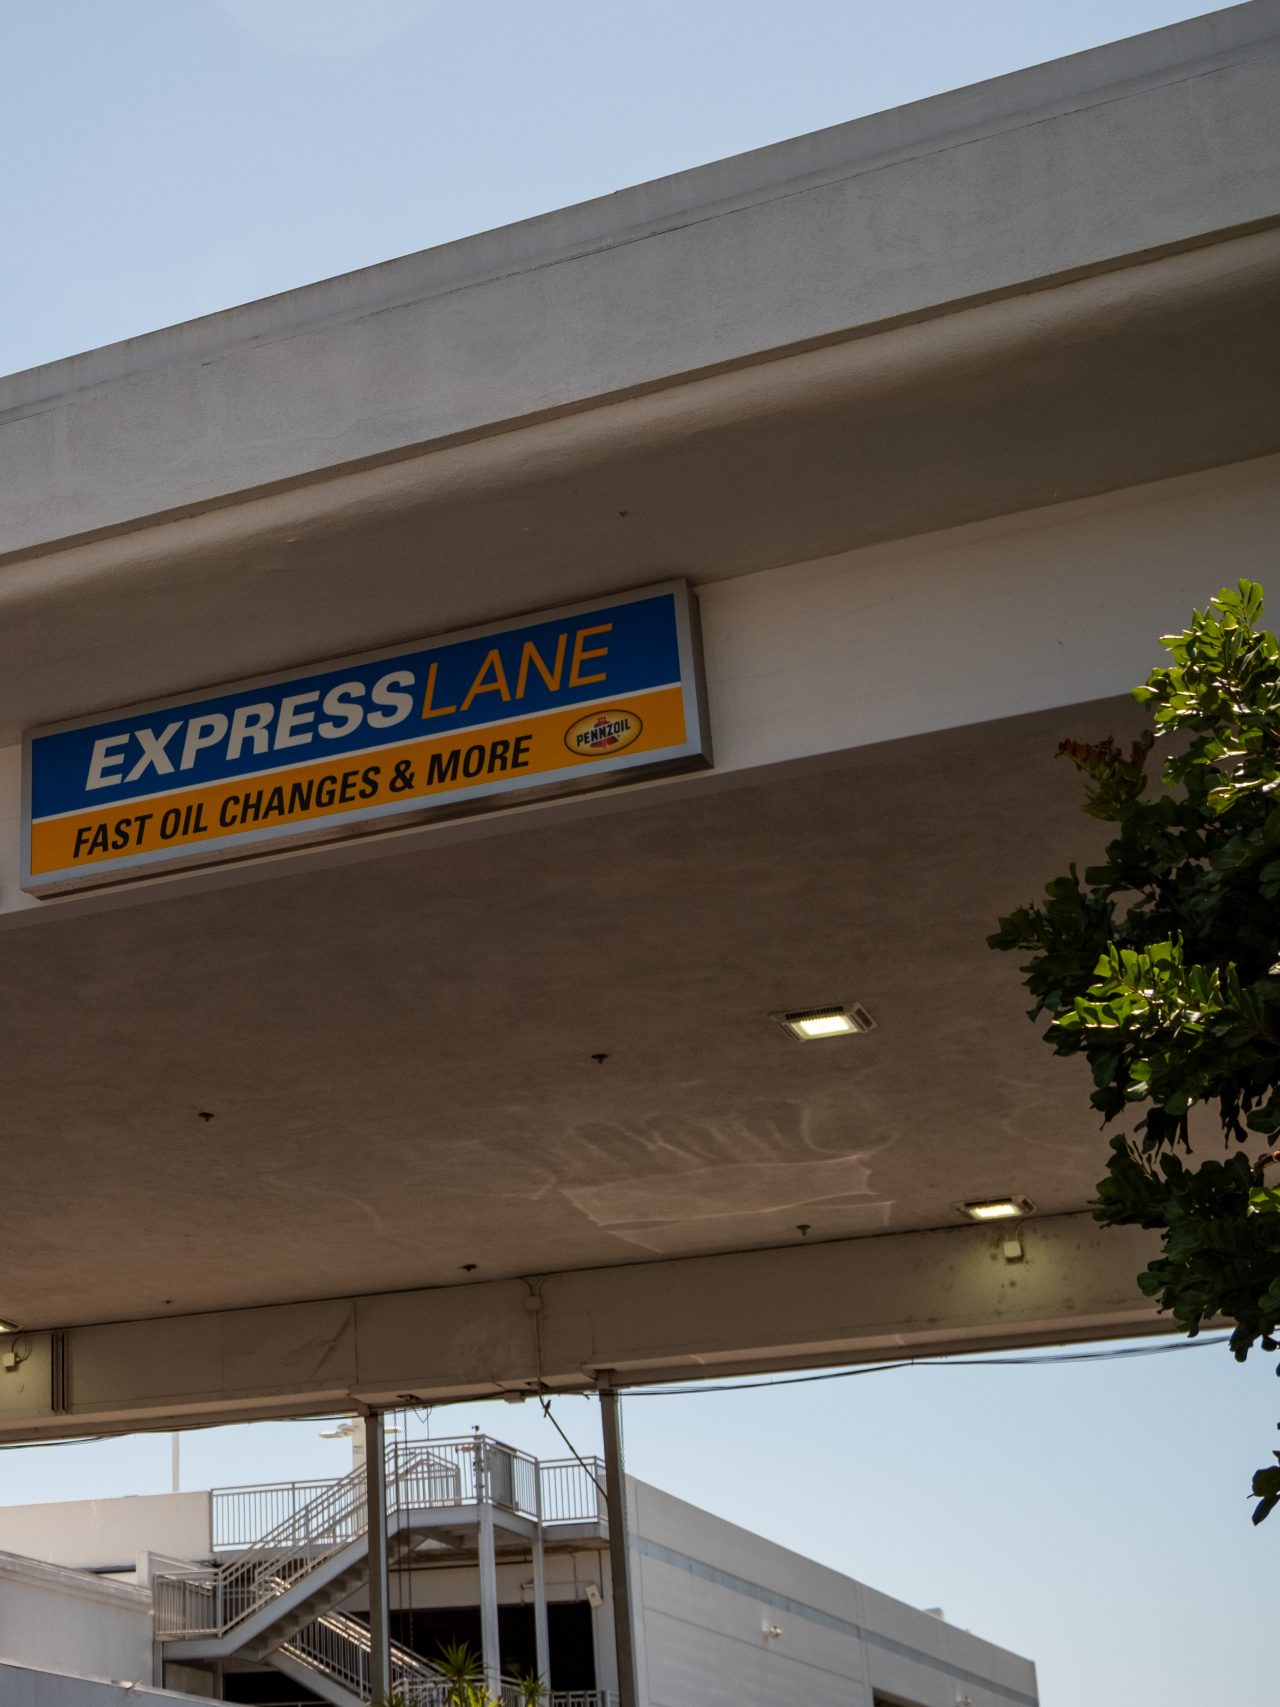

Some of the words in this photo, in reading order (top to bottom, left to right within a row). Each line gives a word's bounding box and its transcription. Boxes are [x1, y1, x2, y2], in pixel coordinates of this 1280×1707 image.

[576, 718, 631, 748] PENNZOIL
[72, 814, 154, 859] FAST
[159, 803, 209, 841] OIL
[219, 765, 382, 829] CHANGES
[388, 759, 416, 793] &
[426, 734, 533, 787] MORE
